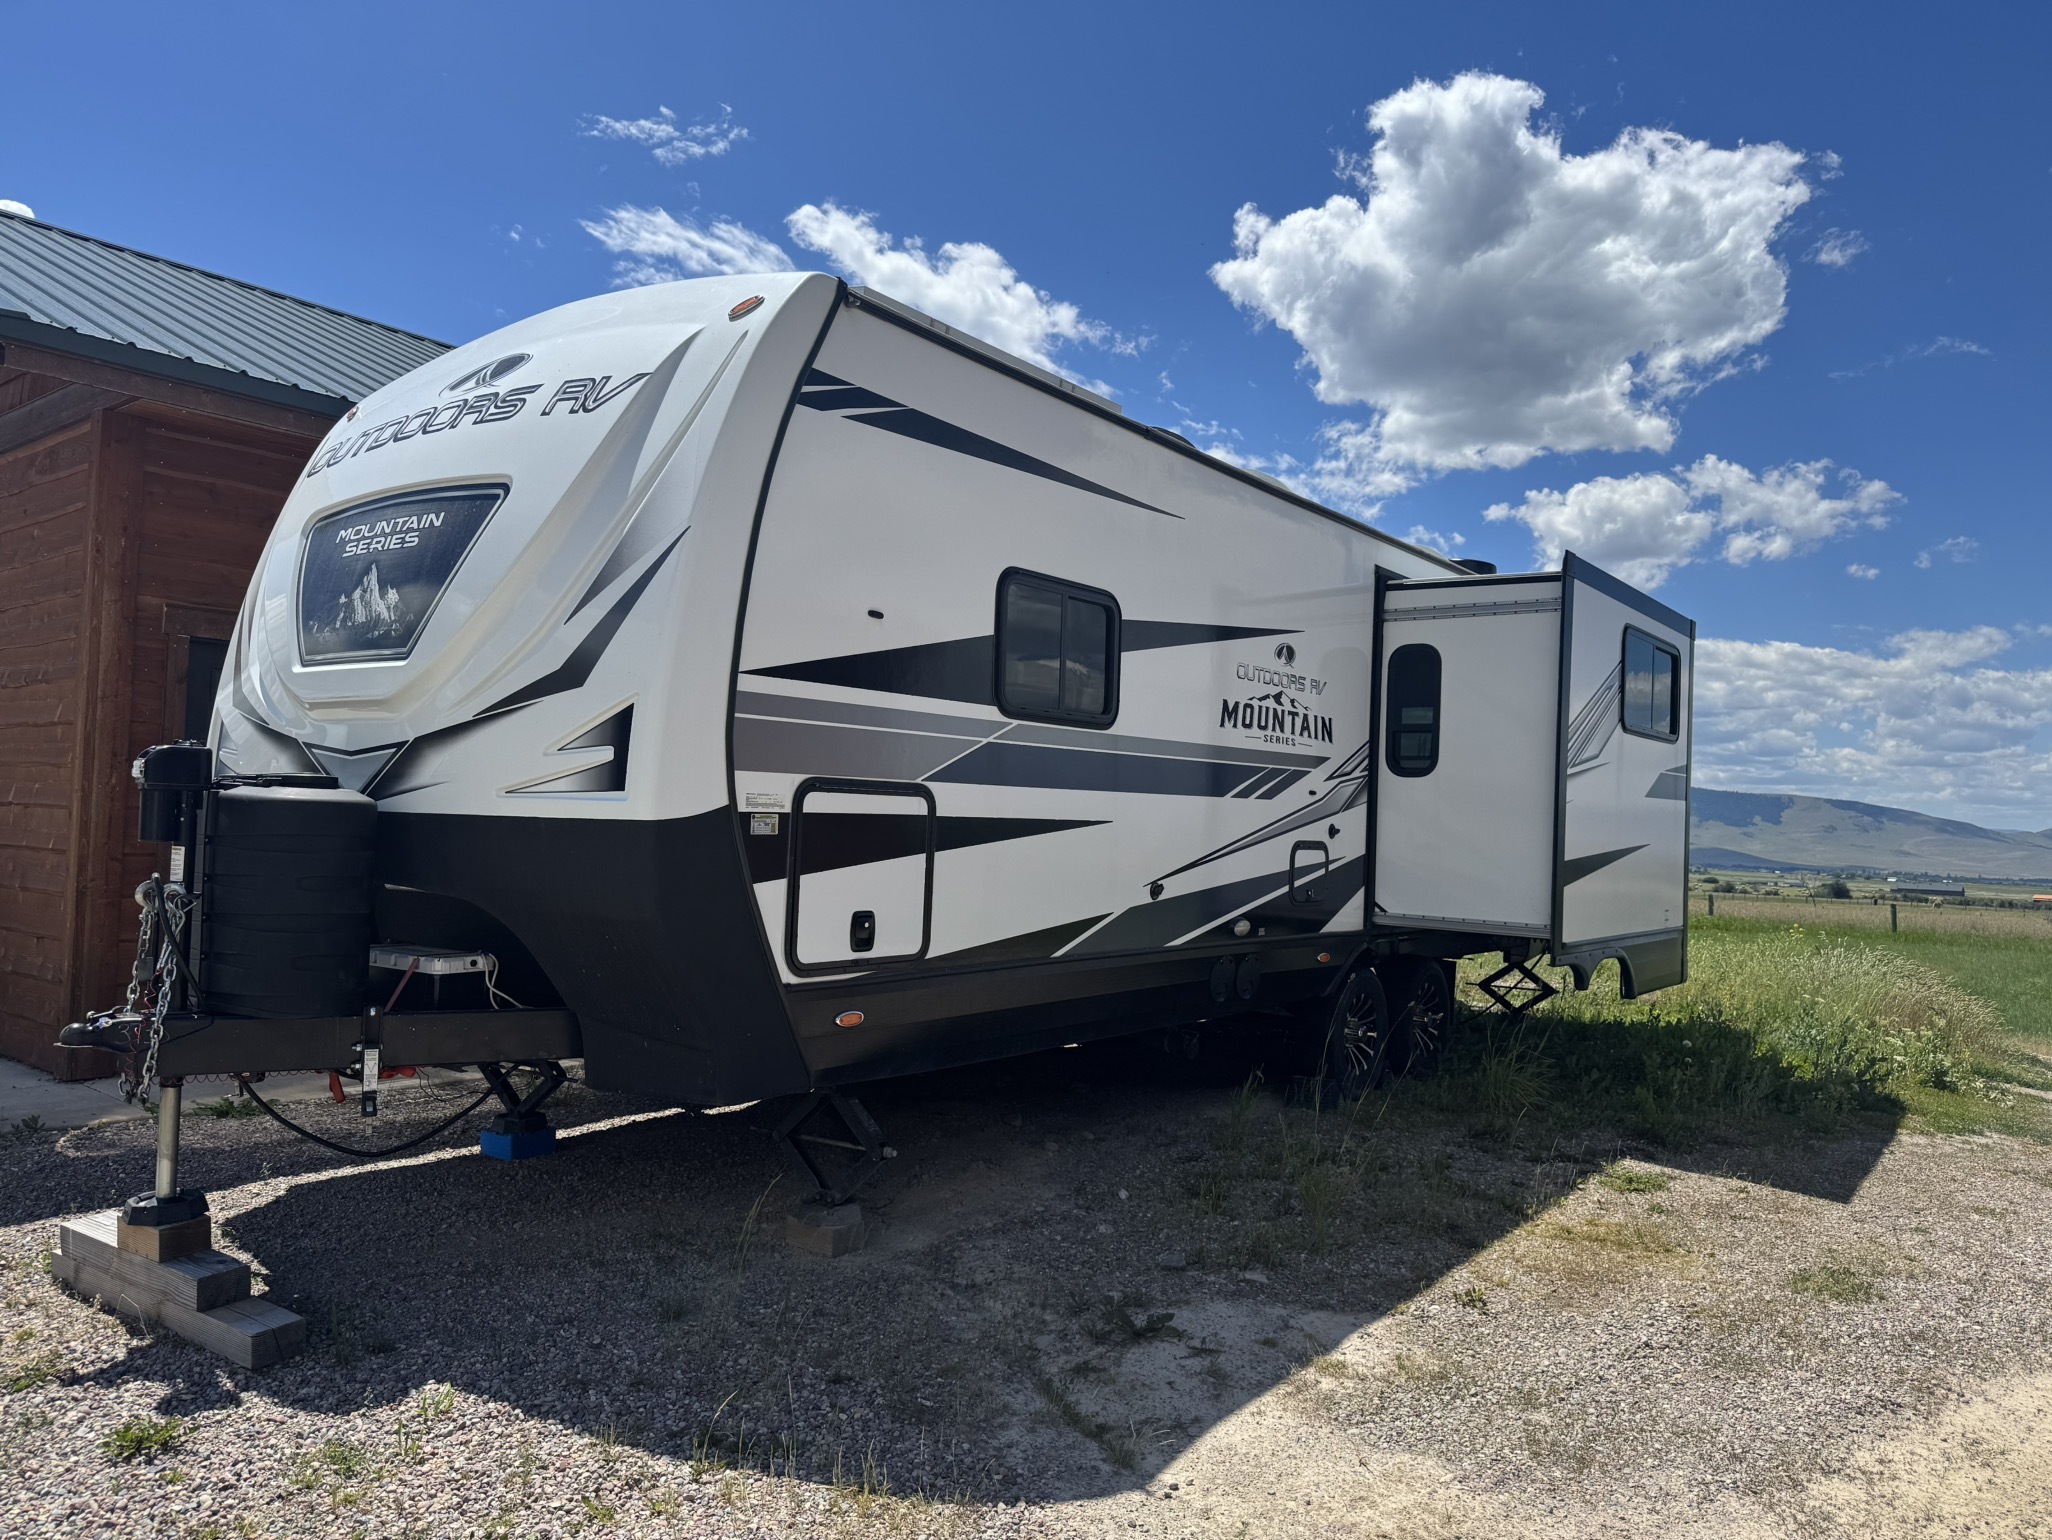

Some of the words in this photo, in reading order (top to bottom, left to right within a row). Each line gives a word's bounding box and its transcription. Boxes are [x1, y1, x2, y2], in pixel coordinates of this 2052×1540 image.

[307, 383, 545, 478] OUTDOORS
[540, 372, 654, 417] RV
[336, 511, 446, 544] MOUNTAIN
[341, 531, 420, 558] SERIES
[1236, 661, 1307, 692] OUTDOORS
[1310, 678, 1328, 695] RV
[1219, 698, 1334, 744] MOUNTAIN
[1263, 734, 1297, 747] SERIES
